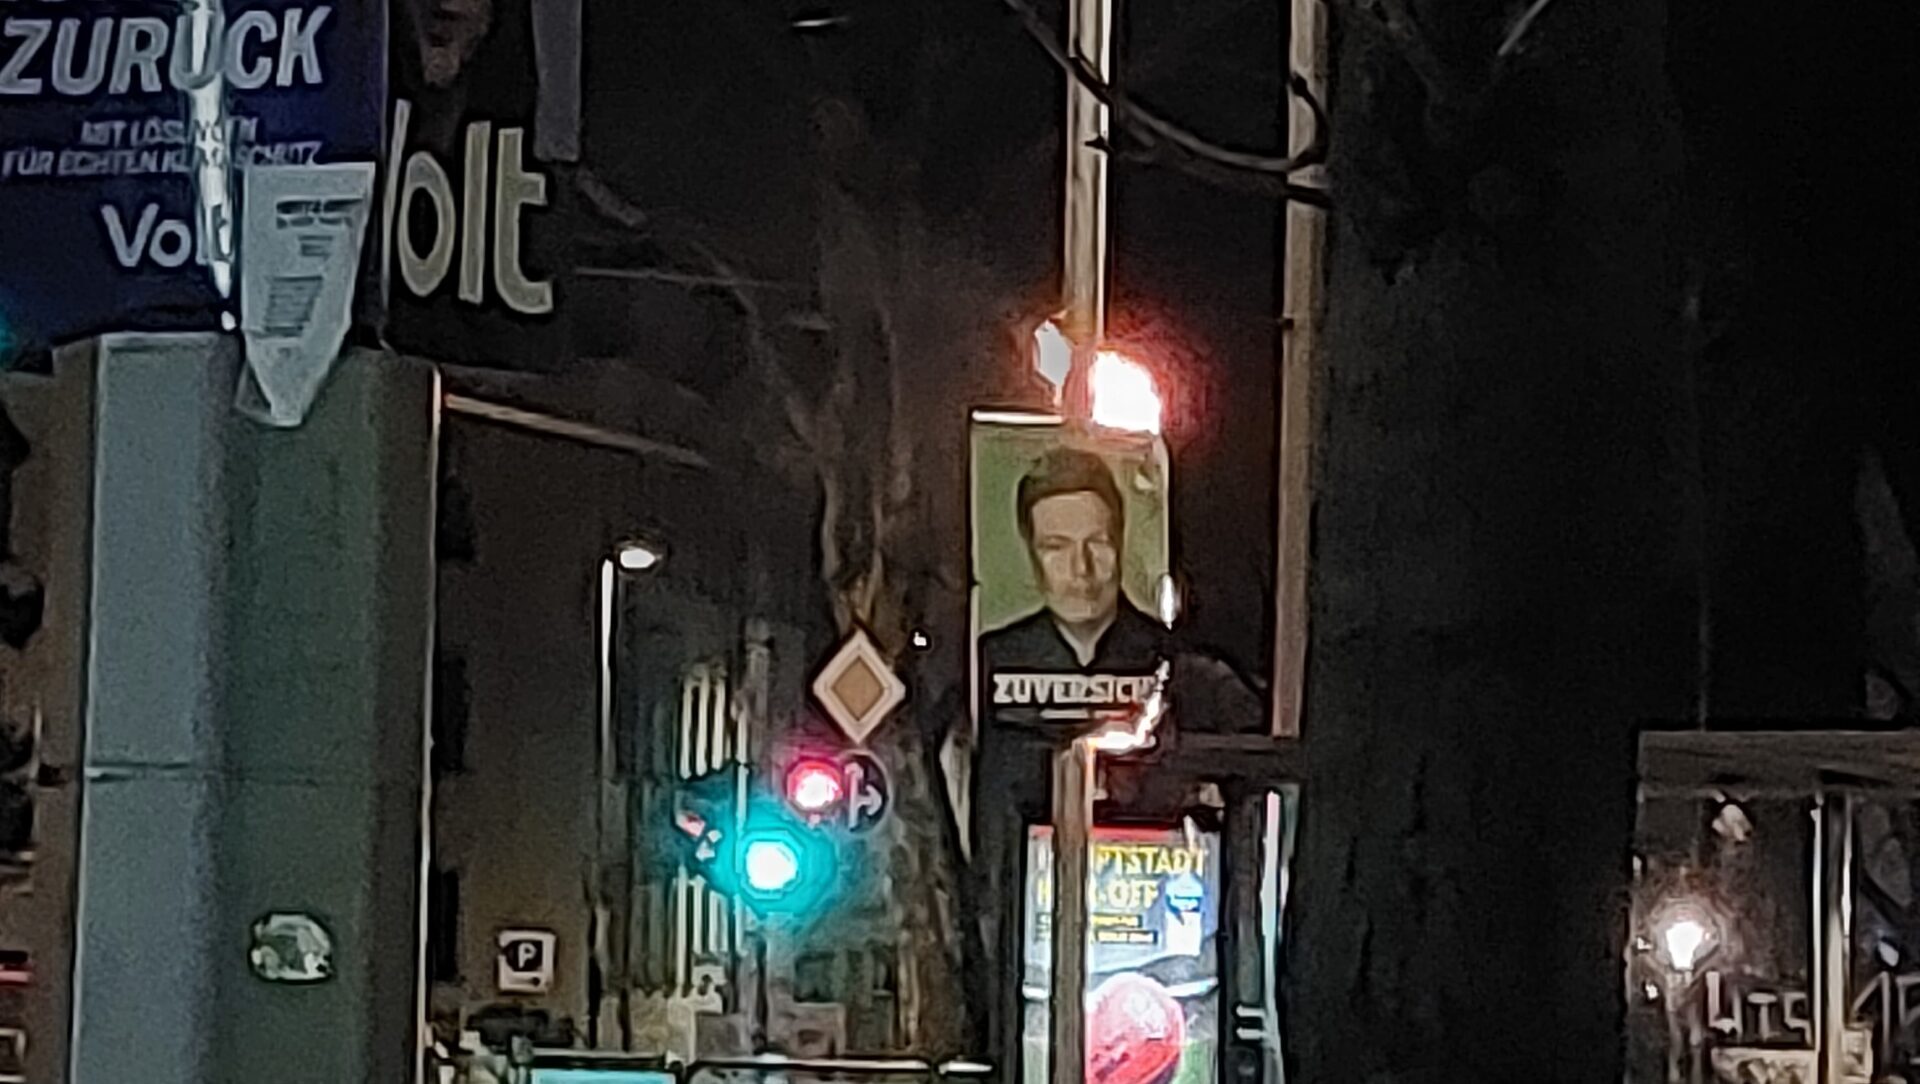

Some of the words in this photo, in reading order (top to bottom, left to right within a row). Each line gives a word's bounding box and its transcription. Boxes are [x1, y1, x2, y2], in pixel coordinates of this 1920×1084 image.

[2, 146, 54, 177] FÜR
[101, 202, 232, 267] Vol
[993, 673, 1157, 704] ZUVERSICH
[518, 942, 537, 968] P
